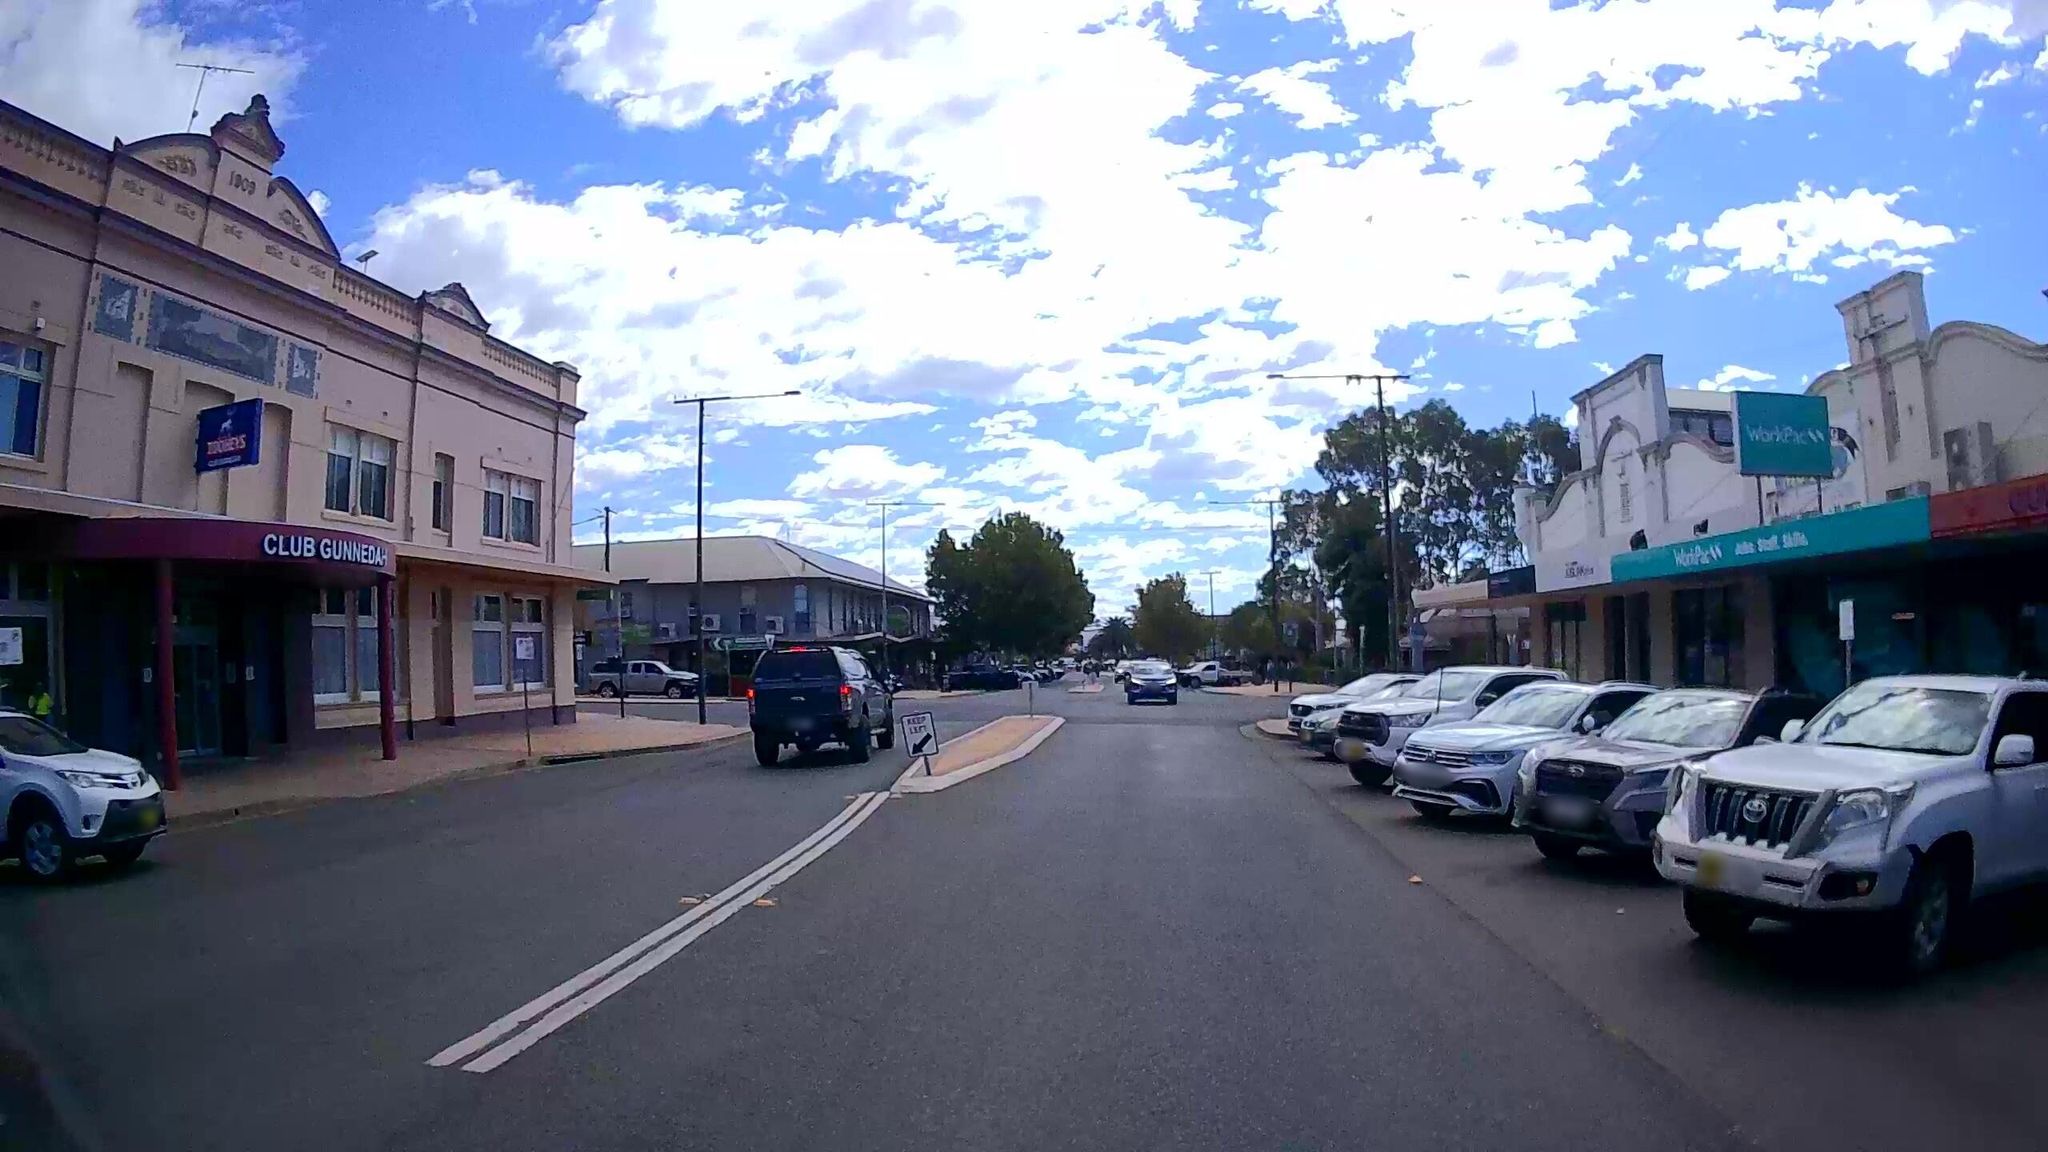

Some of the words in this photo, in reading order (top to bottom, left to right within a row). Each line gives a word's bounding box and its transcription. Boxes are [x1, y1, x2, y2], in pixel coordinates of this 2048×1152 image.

[1745, 424, 1807, 444] WorkPac
[263, 533, 316, 557] CLUB
[319, 538, 388, 566] GUNNEDAH
[907, 716, 926, 725] KEEP
